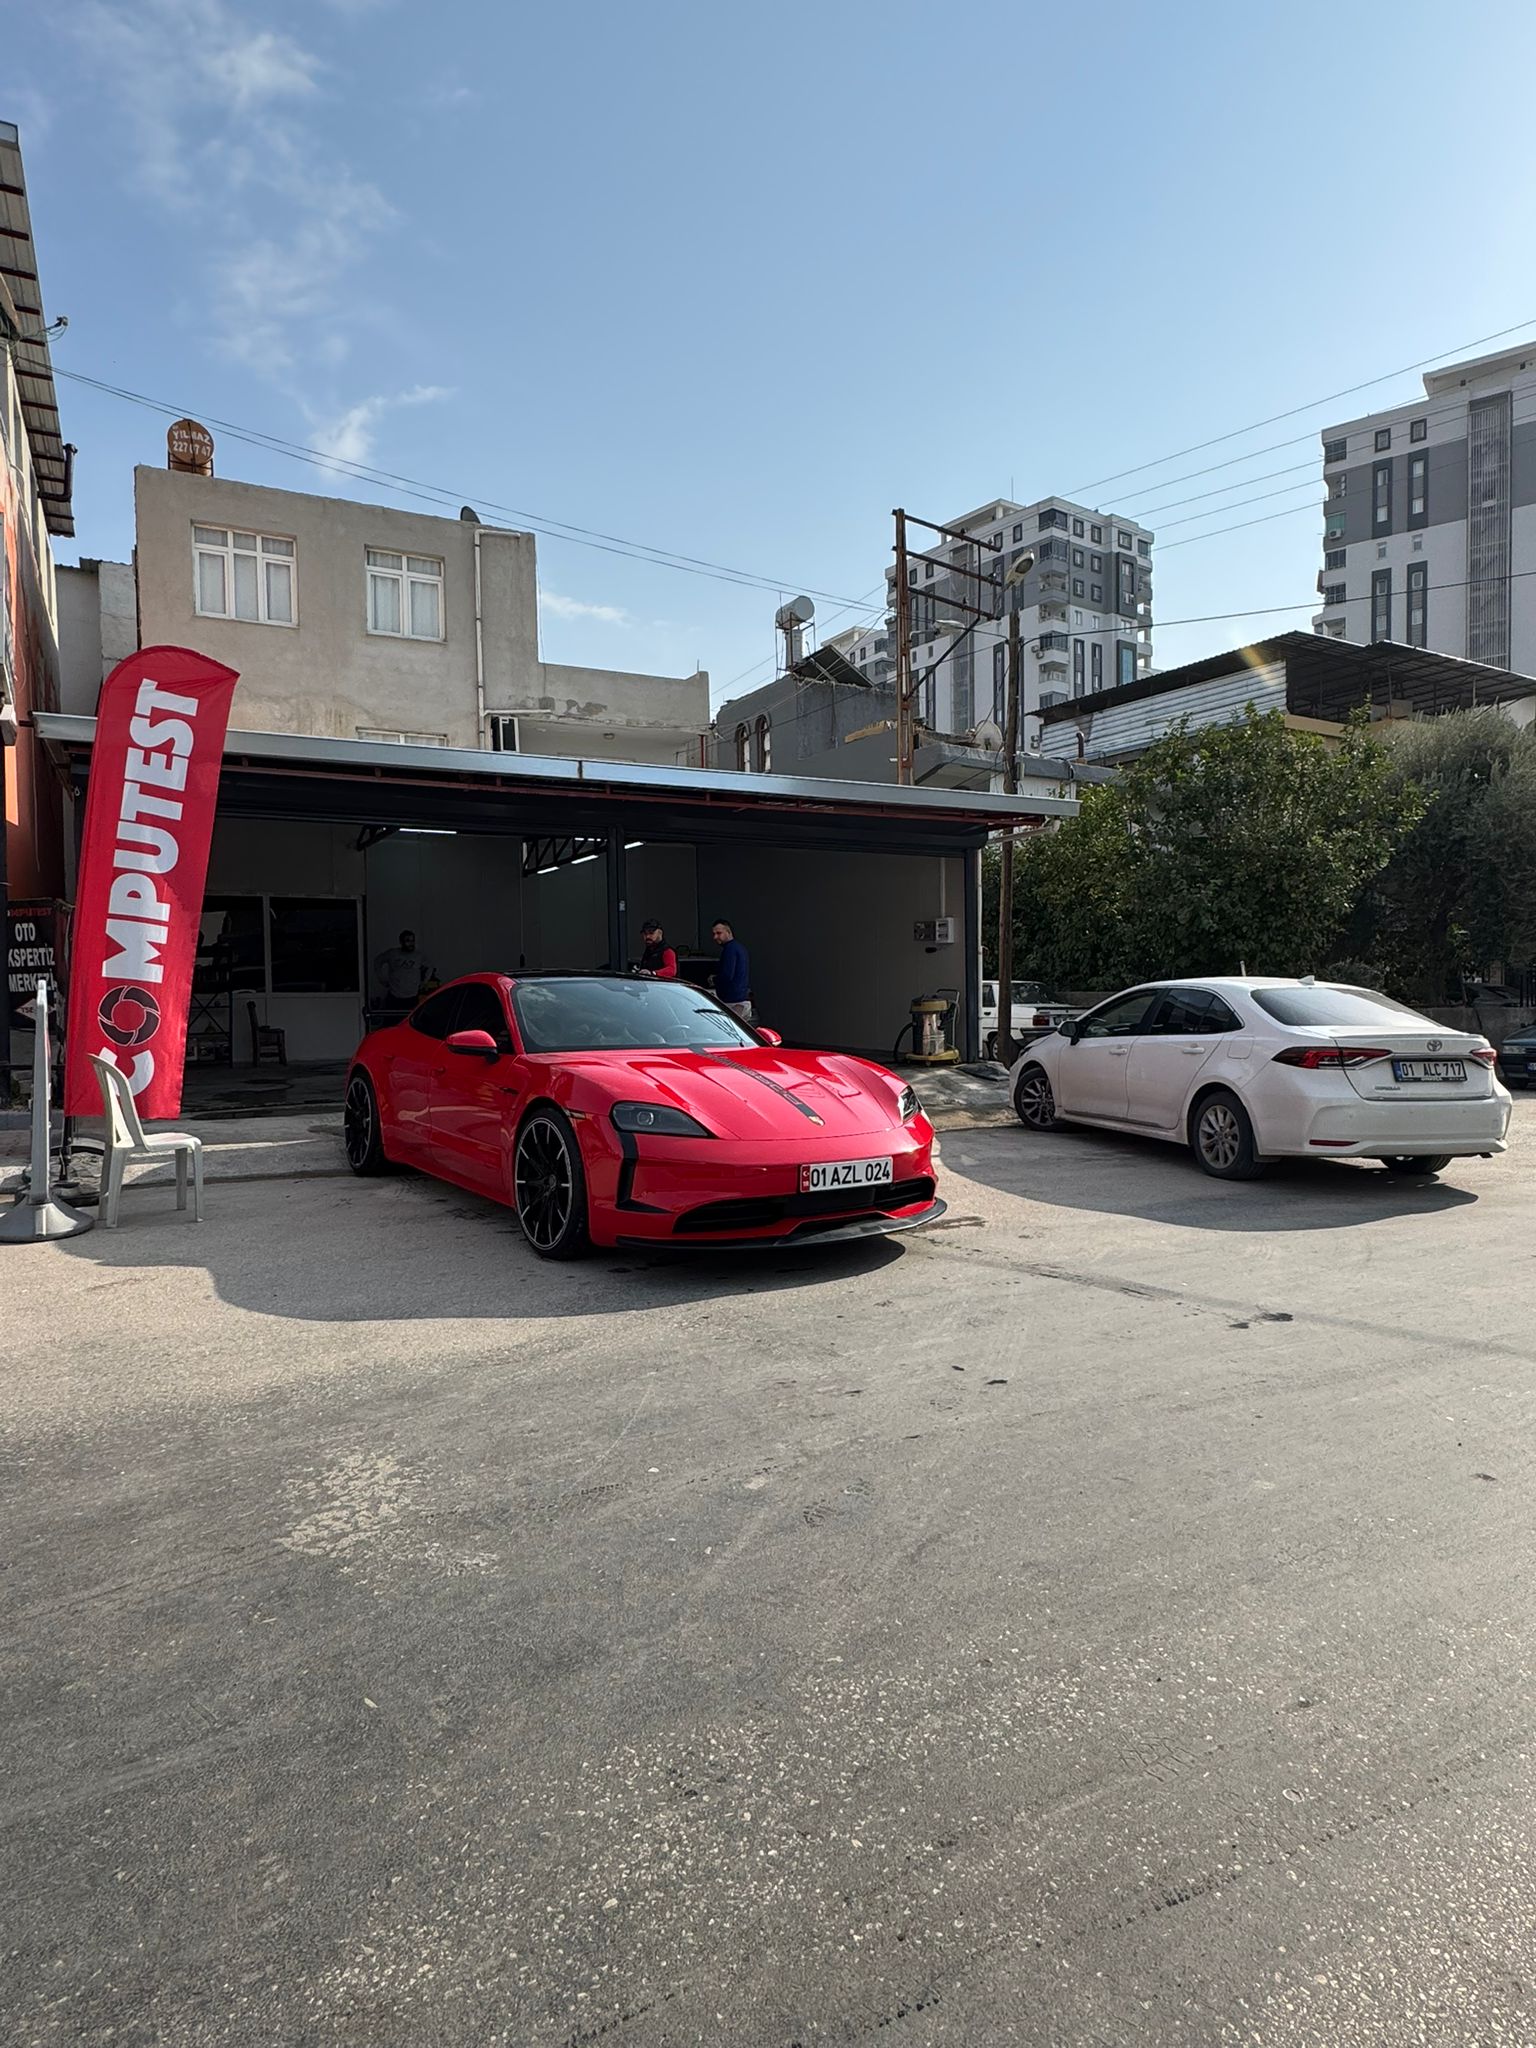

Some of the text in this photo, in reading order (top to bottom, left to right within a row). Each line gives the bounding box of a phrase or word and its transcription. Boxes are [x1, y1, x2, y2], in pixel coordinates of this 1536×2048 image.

[173, 441, 188, 453] 227
[15, 923, 36, 942] OTO
[1401, 1063, 1461, 1076] 01 ALC 717
[811, 1162, 890, 1188] 01 AZL 024
